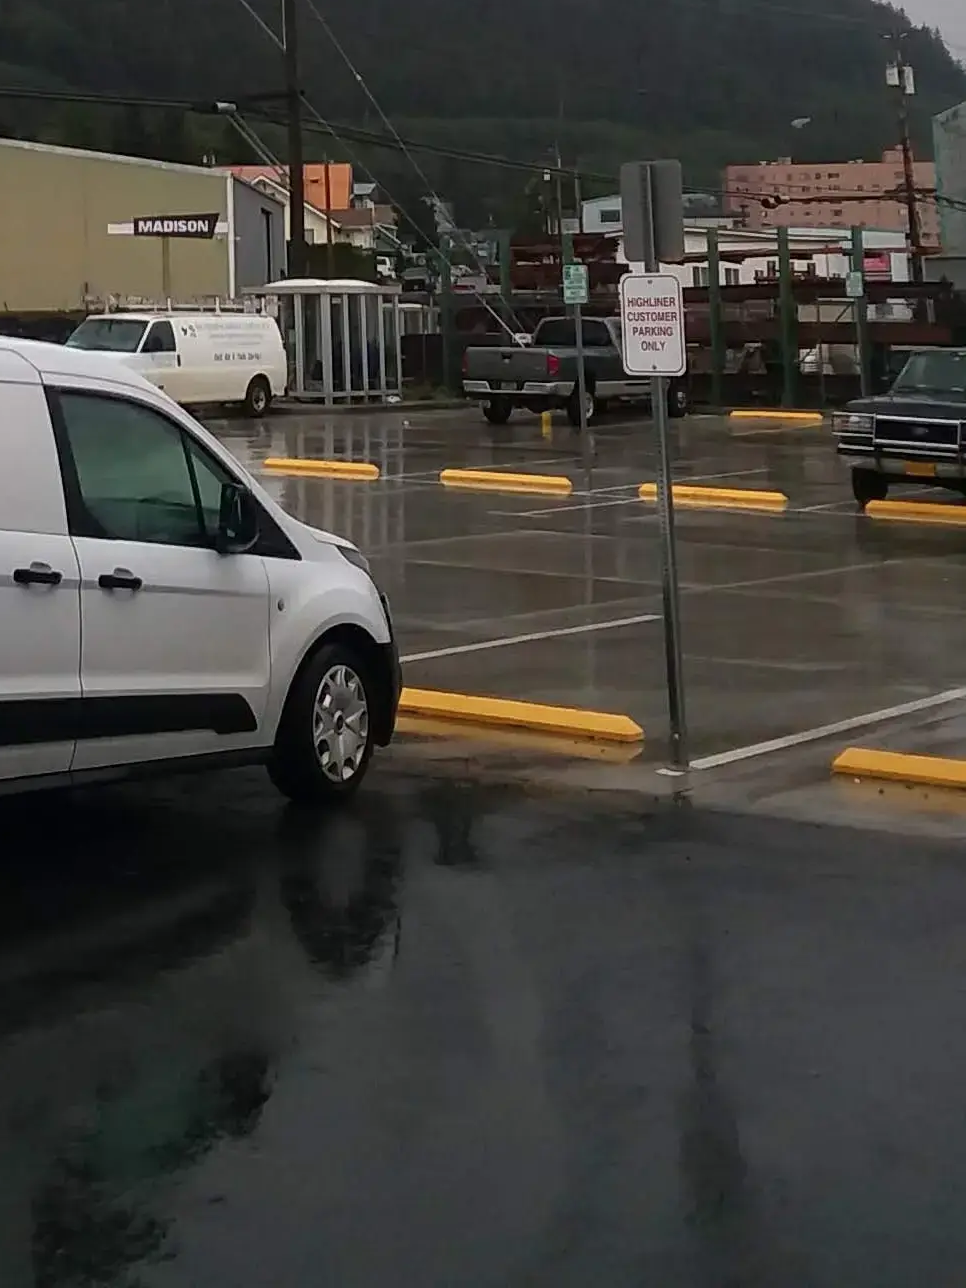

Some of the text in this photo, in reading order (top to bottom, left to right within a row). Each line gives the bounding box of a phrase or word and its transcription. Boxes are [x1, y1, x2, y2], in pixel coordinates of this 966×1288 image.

[138, 220, 209, 233] MADISON
[627, 297, 676, 308] HIGHLINER
[627, 312, 678, 322] CUSTOMER
[632, 326, 674, 337] PARKING
[641, 341, 666, 351] ONLY
